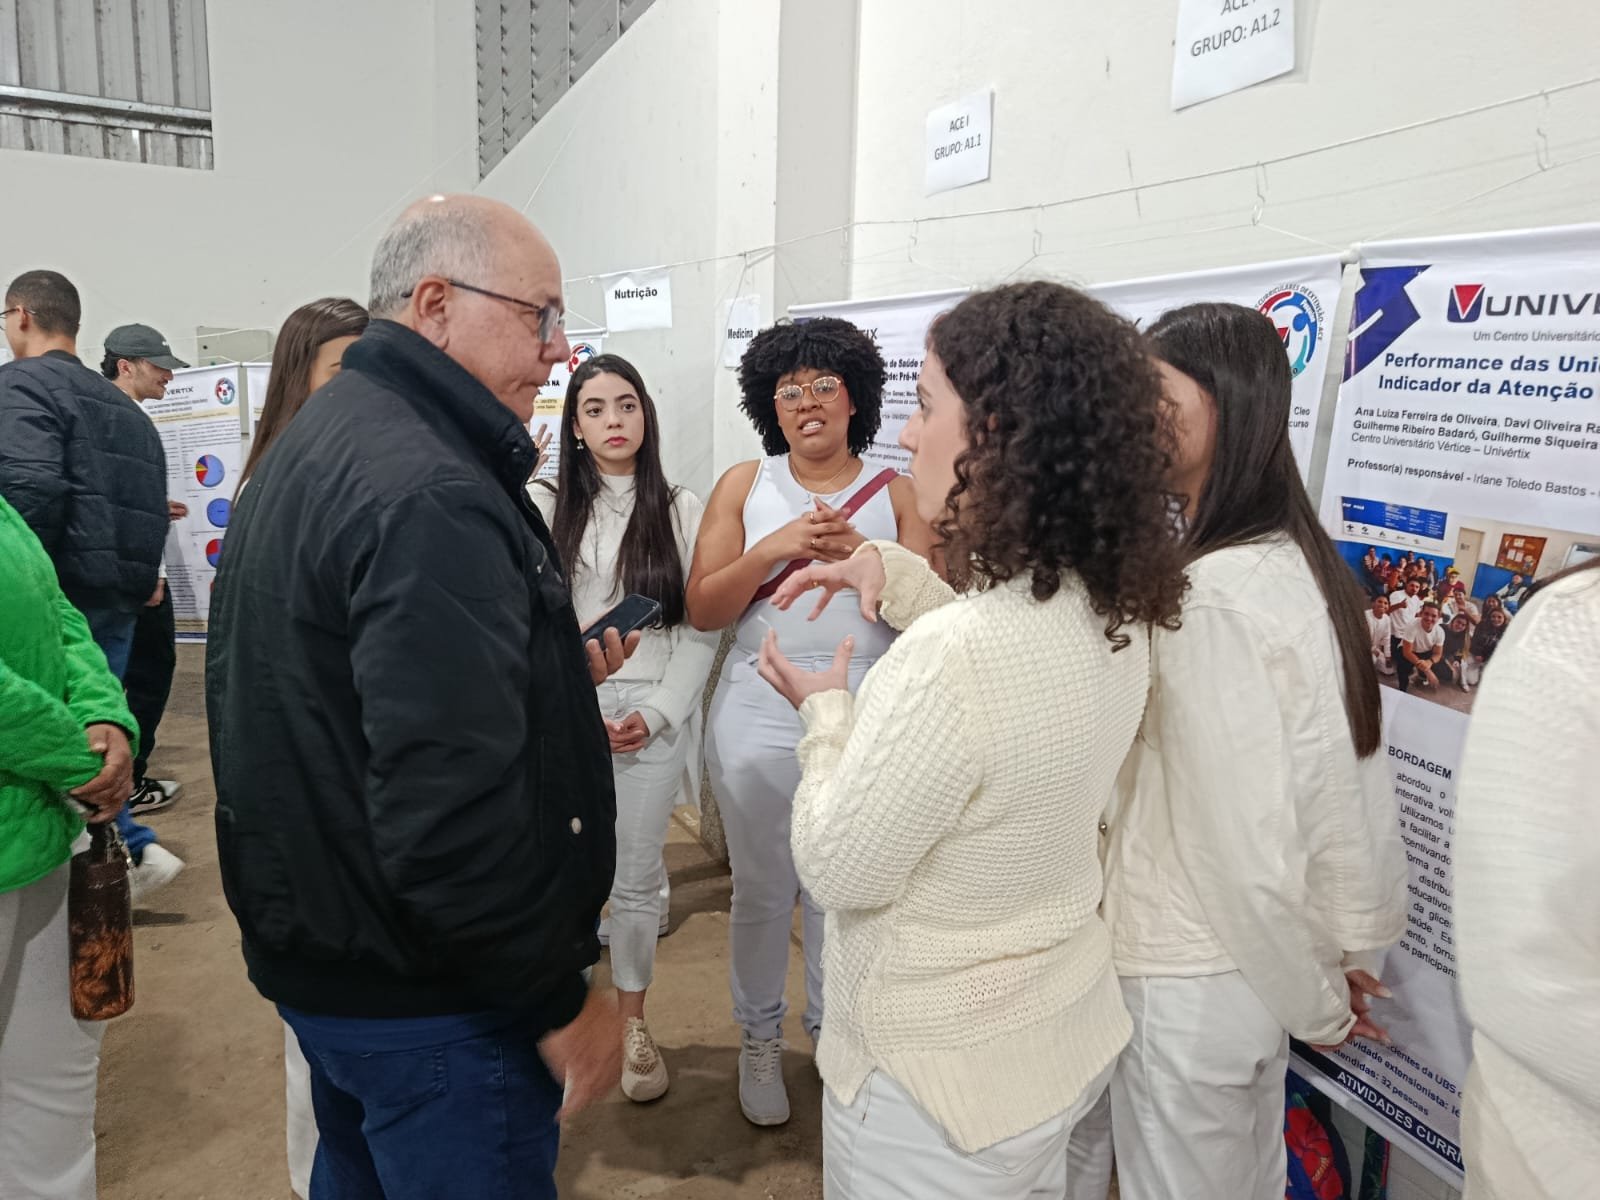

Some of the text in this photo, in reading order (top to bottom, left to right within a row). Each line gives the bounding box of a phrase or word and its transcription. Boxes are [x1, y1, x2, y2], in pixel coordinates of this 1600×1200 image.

[1190, 8, 1281, 57] GRUPO: A1.2
[949, 116, 965, 132] ACE
[934, 133, 981, 160] GRUPO: A1.1
[614, 286, 658, 300] Nutrição
[727, 327, 753, 339] Medicina
[1473, 331, 1490, 341] Um
[1493, 331, 1528, 341] Centro
[1384, 352, 1600, 373] Performance das Uni
[1378, 375, 1593, 402] Indicador da Atenção
[1355, 407, 1374, 417] Ana
[1376, 408, 1399, 419] Luiza
[1401, 410, 1438, 422] Ferreira
[1440, 413, 1453, 423] de
[1504, 417, 1530, 429] Davi
[1533, 419, 1582, 433] Oliveira
[1351, 432, 1381, 444] Centro
[1383, 435, 1435, 450] Universitário
[1437, 440, 1471, 453] Vértice
[1483, 445, 1531, 459] Univértix
[1353, 420, 1598, 450] Guilherme Ribeiro Badaró, Guilherme Siqueira
[1347, 458, 1403, 476] Professor(a)
[1404, 466, 1464, 482] responsável
[1506, 476, 1542, 491] Toledo
[1545, 482, 1587, 497] Bastos
[1387, 745, 1452, 780] BORDAGEM
[1396, 772, 1432, 793] abordou
[1400, 803, 1444, 831] Utilizamos
[1409, 822, 1441, 844] facilitar
[1418, 875, 1452, 896] distribu
[1434, 866, 1446, 878] de
[1413, 902, 1425, 913] da
[1349, 1040, 1383, 1063] ividade
[1384, 1061, 1449, 1109] extensionista:
[1387, 1045, 1457, 1094] cientes da UBS
[1337, 1071, 1413, 1129] ATIVIDADES
[1380, 1075, 1392, 1089] 32
[1392, 1087, 1429, 1116] pessoas
